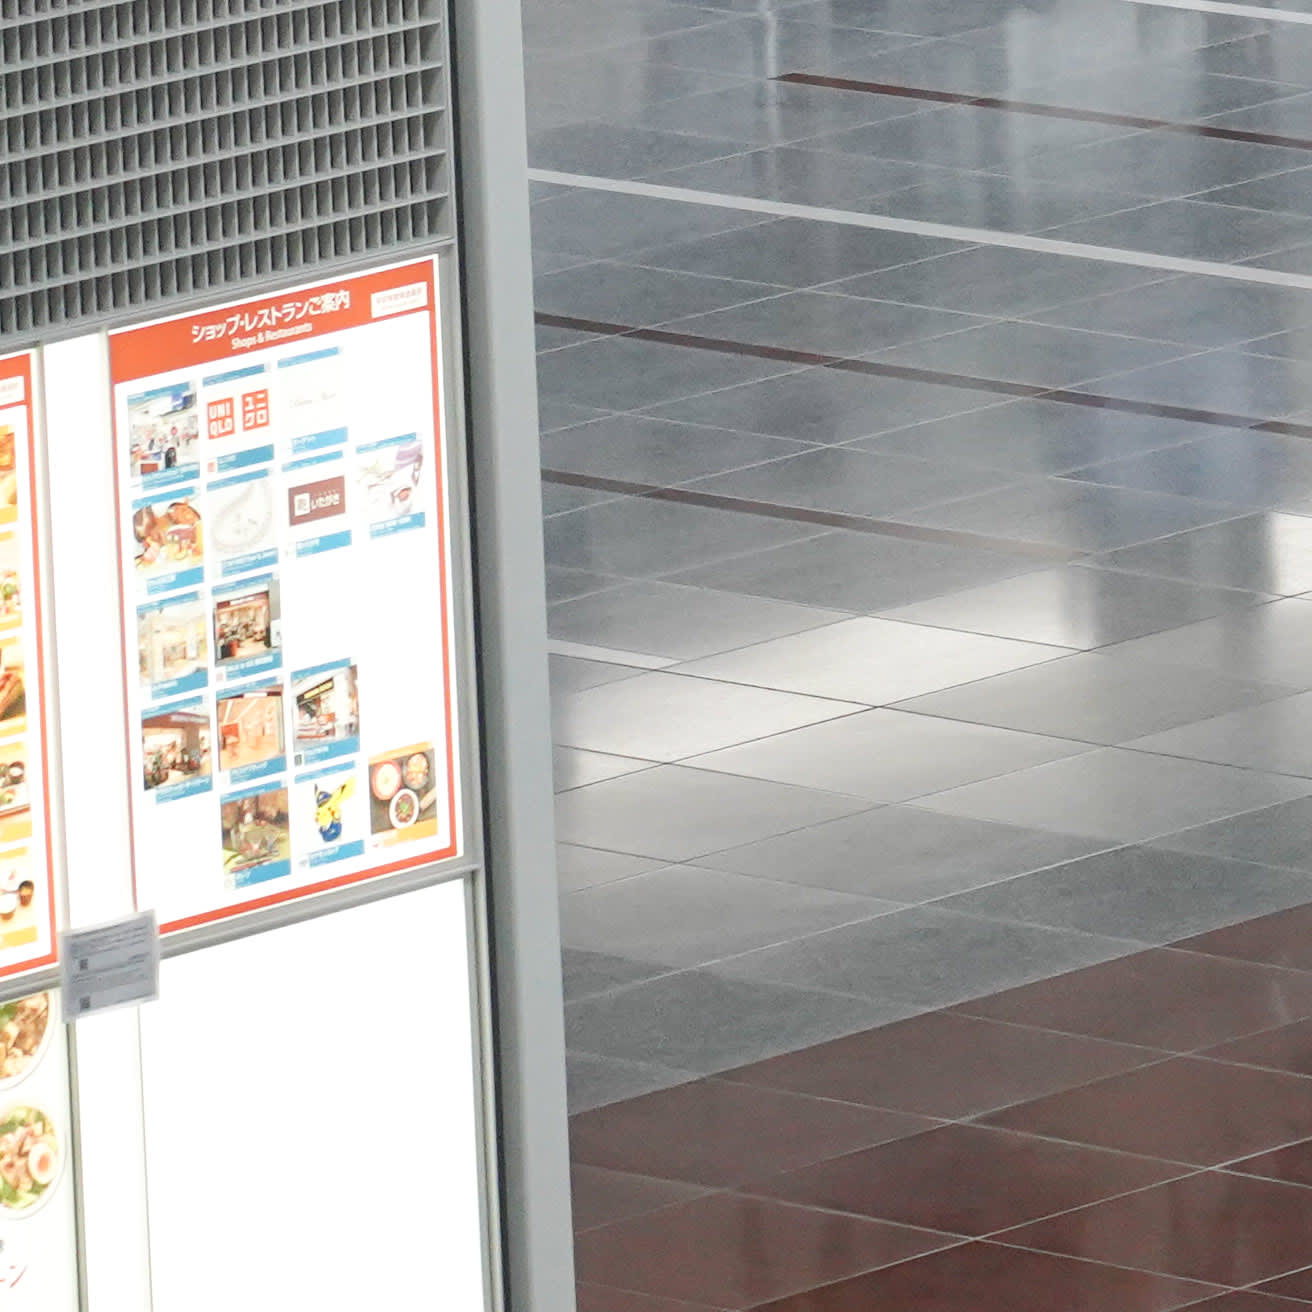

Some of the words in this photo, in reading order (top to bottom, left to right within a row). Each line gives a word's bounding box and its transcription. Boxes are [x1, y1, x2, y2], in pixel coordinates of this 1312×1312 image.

[231, 333, 257, 350] Shops
[265, 323, 312, 341] Restaurants
[209, 401, 231, 419] UNI
[210, 418, 232, 437] QLO
